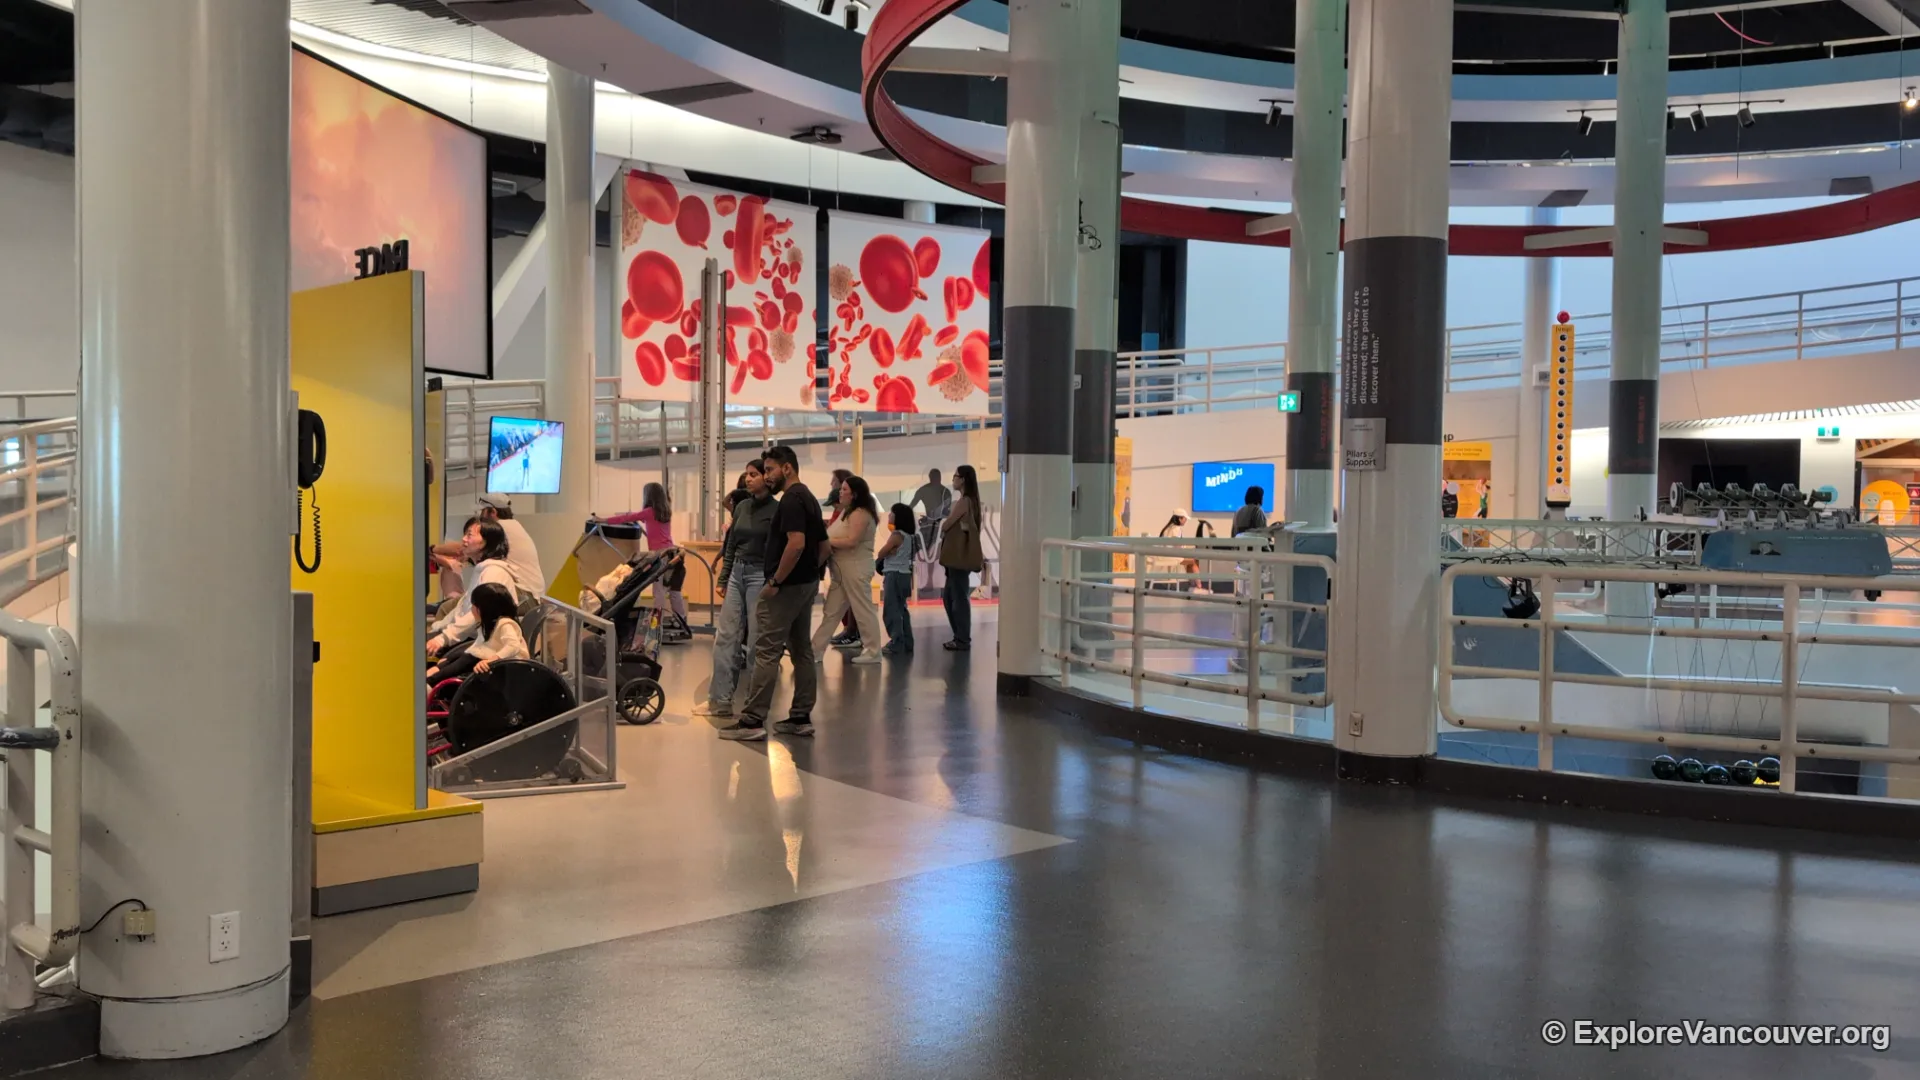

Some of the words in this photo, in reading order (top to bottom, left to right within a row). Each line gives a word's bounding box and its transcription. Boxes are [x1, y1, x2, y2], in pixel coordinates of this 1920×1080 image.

[1362, 286, 1370, 297] to
[1362, 298, 1369, 307] is
[1361, 309, 1370, 333] point
[1351, 353, 1359, 405] understand
[1360, 352, 1369, 404] discovered;
[1370, 366, 1379, 404] discover
[1346, 450, 1368, 458] Pillars
[1346, 458, 1376, 467] Support
